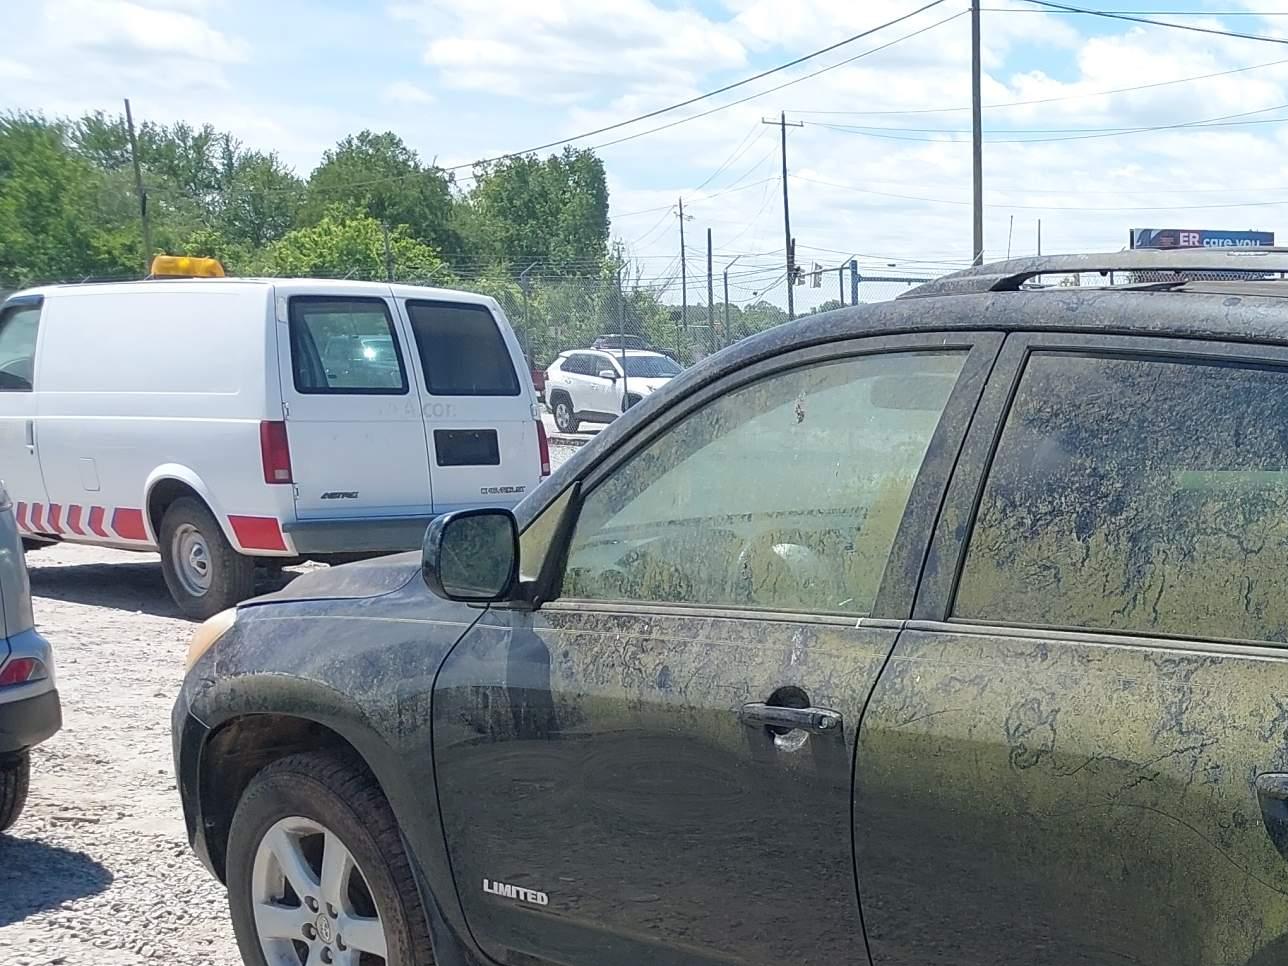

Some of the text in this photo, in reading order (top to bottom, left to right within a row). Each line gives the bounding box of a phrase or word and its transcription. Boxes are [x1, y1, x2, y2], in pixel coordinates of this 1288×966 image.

[1179, 231, 1200, 246] ER
[1202, 237, 1233, 247] care
[483, 878, 549, 905] LIMITED
